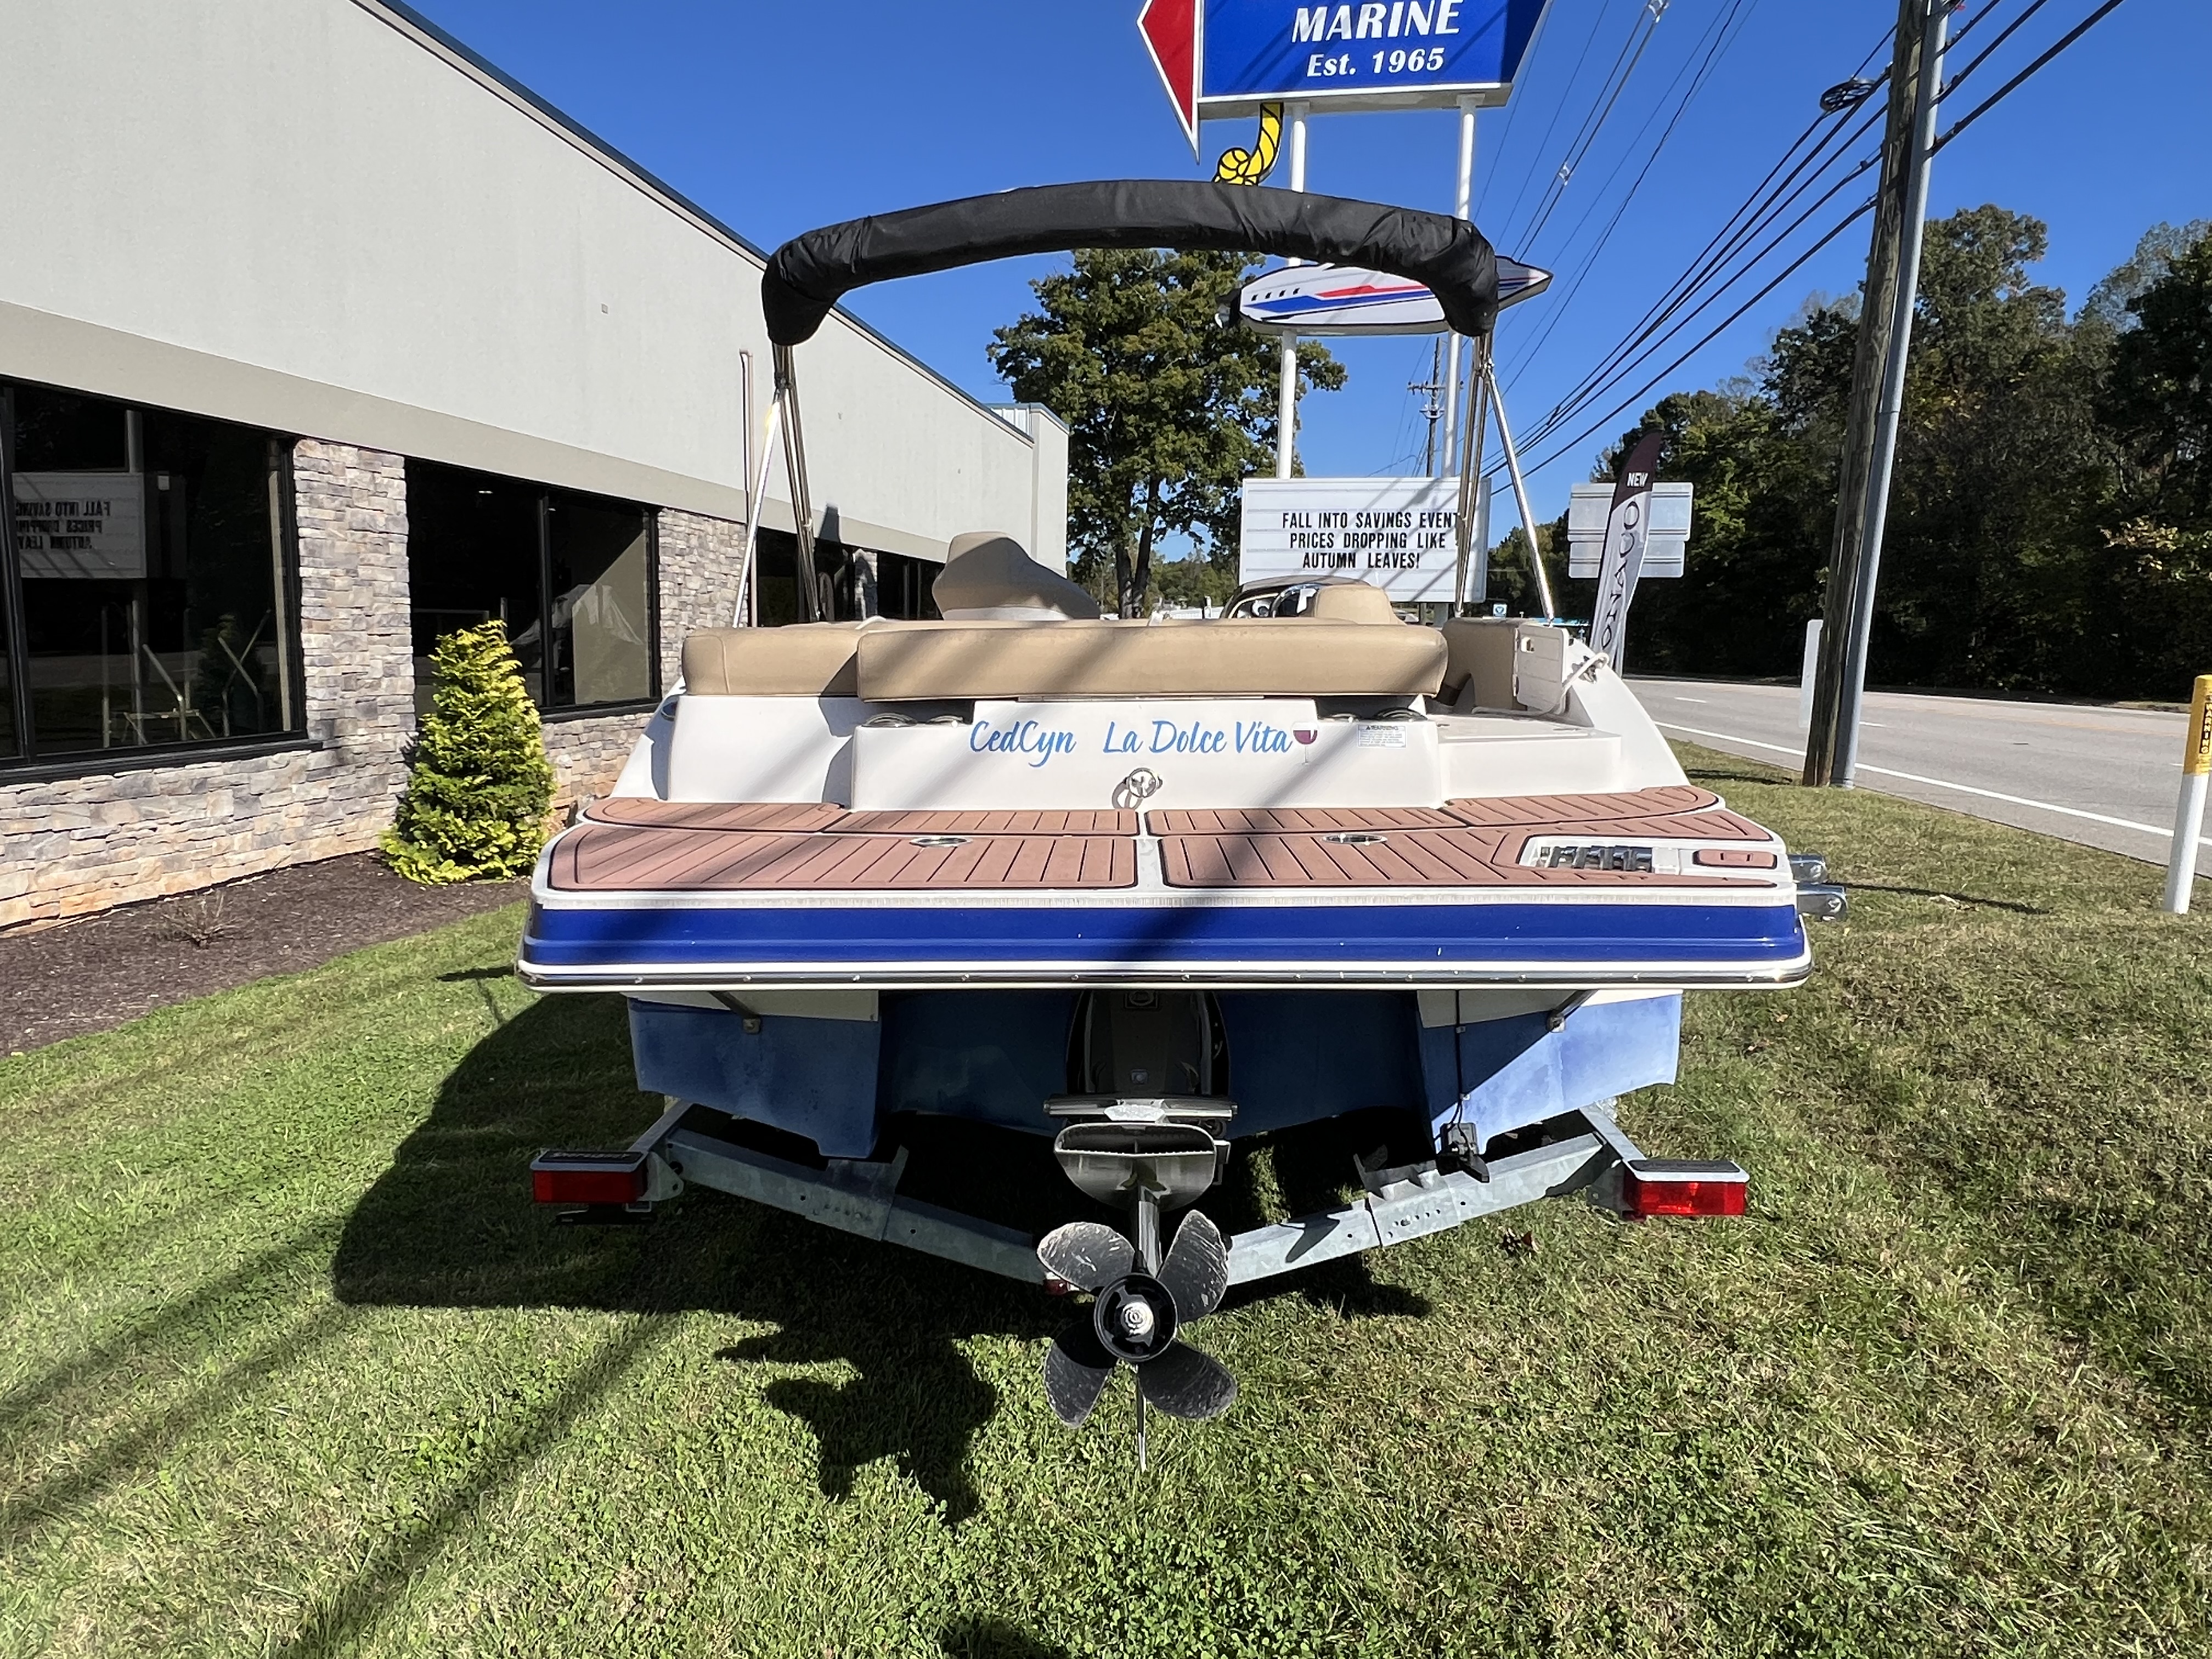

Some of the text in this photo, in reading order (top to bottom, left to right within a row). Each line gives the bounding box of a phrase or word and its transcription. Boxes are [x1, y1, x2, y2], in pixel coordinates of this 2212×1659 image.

[1291, 0, 1463, 42] MARINE
[1307, 48, 1444, 76] Est. 1965
[1627, 472, 1649, 487] NEW
[1282, 512, 1457, 528] FALL INTO SAVINGS EVENT
[1290, 533, 1446, 549] PRICES DROPPING LIKE
[1302, 552, 1420, 568] AUTUMN LEAVES!
[969, 720, 1293, 768] CedCyn La Dolce Vita
